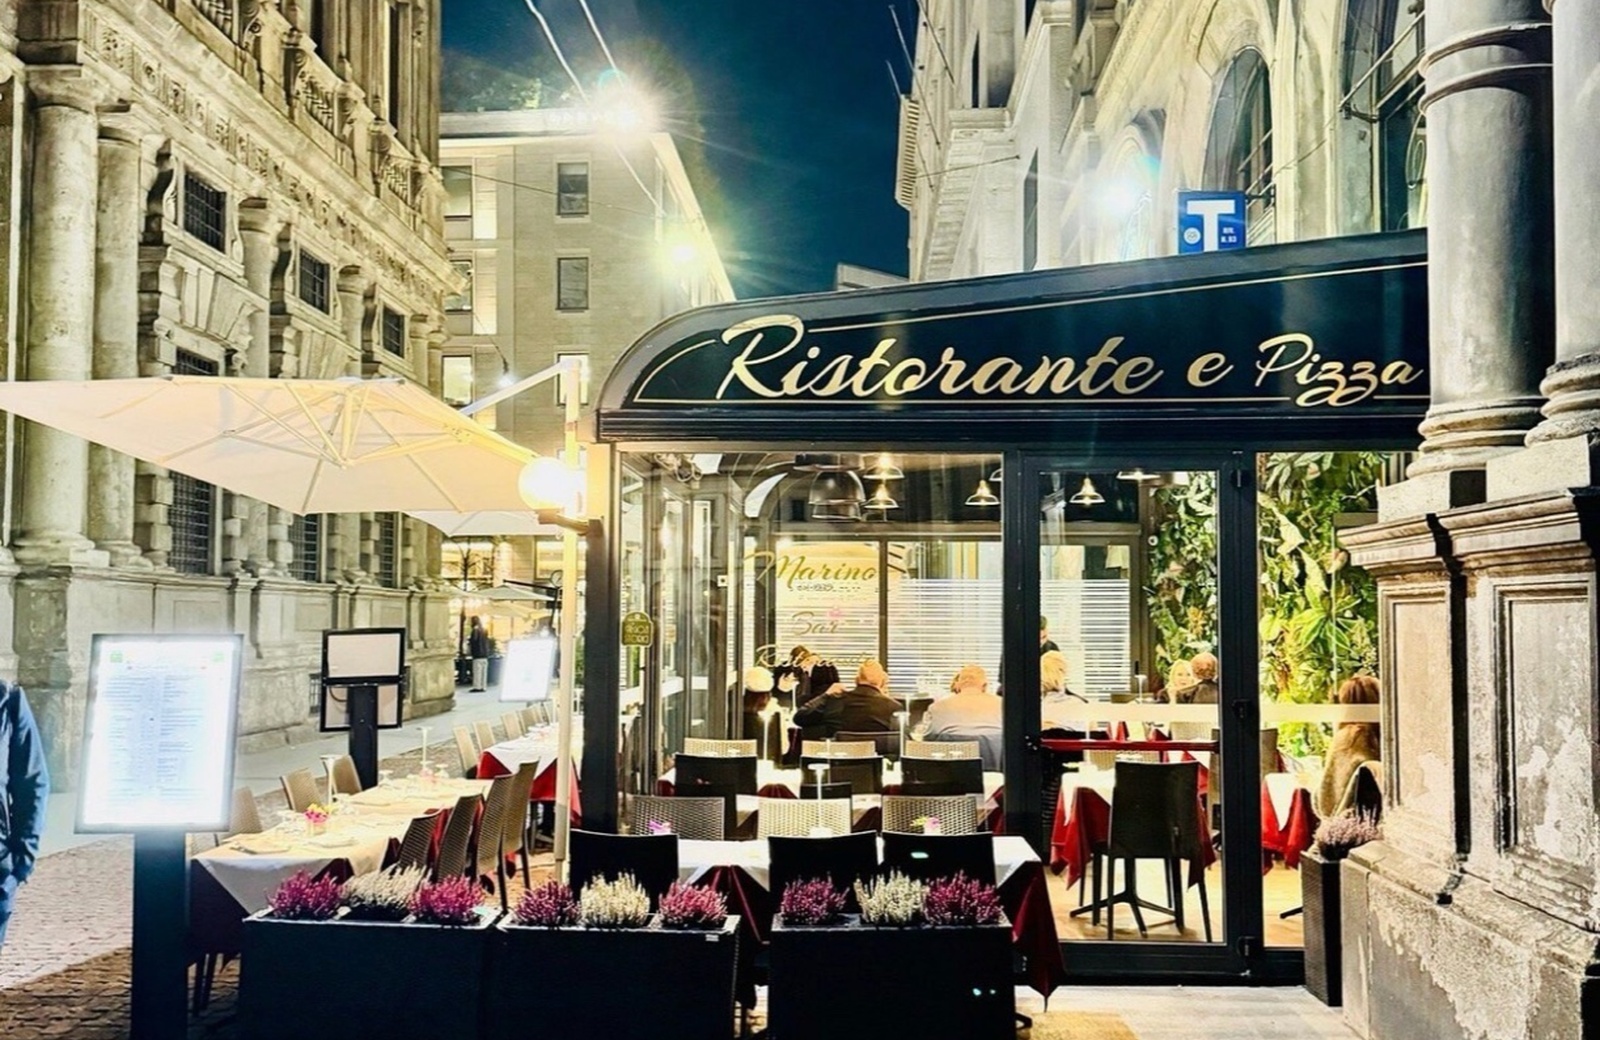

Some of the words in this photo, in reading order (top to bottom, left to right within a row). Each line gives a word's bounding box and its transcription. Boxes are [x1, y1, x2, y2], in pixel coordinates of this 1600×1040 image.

[1186, 199, 1236, 252] T
[715, 313, 1164, 400] Ristorante
[1186, 352, 1234, 387] e
[1255, 332, 1424, 407] Pizza
[743, 551, 877, 590] Marino
[791, 611, 841, 635] Bar
